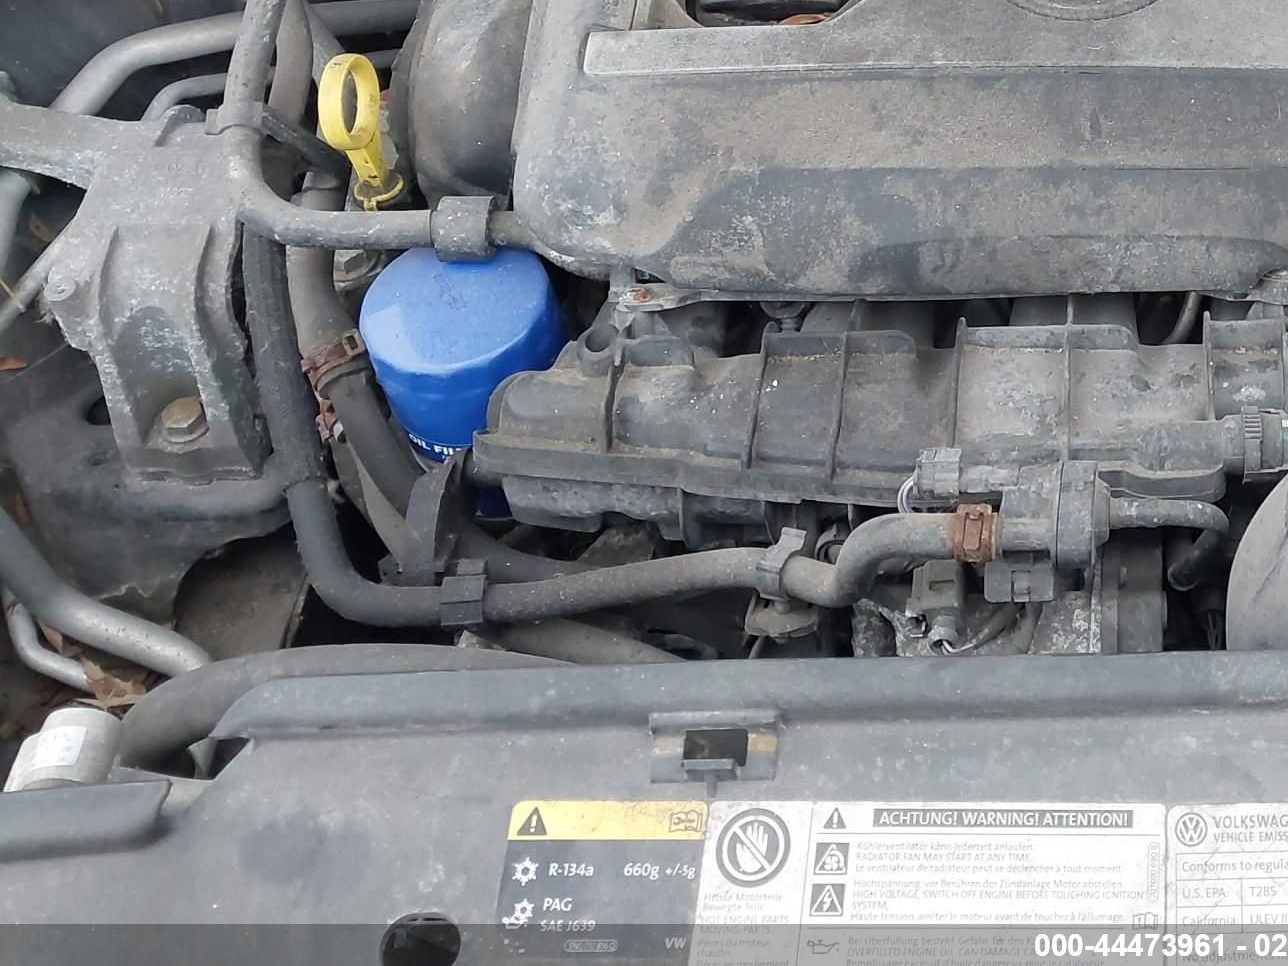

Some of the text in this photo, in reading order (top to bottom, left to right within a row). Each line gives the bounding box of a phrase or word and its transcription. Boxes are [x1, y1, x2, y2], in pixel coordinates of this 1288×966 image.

[408, 433, 431, 450] OIL
[879, 811, 1128, 827] ACHTUNG! WARNING! ATTENTION!
[1213, 831, 1254, 843] VEHICLE
[856, 852, 902, 861] RADIATOR
[904, 852, 920, 861] FAN
[922, 852, 943, 861] MAY
[947, 852, 971, 862] START
[973, 853, 985, 862] AT
[987, 853, 1006, 862] ANY
[549, 863, 594, 877] R-134a
[623, 863, 660, 880] 660g
[917, 864, 927, 873] de
[995, 865, 1005, 873] se
[1063, 864, 1082, 874] tout
[1182, 860, 1236, 873] Conforms
[1240, 859, 1252, 871] to
[853, 890, 875, 899] HIGH
[923, 890, 958, 899] SWITCH
[960, 890, 976, 899] OFF
[979, 890, 1013, 900] ENGINE
[1016, 890, 1049, 900] BEFORE
[1051, 890, 1100, 900] TOUCHING
[1102, 890, 1144, 900] IGNITION
[543, 898, 575, 912] PAG
[850, 912, 878, 922] Haute
[960, 913, 992, 922] moteur
[1019, 912, 1032, 922] de
[540, 920, 596, 932] SAE J639
[664, 938, 687, 949] VW
